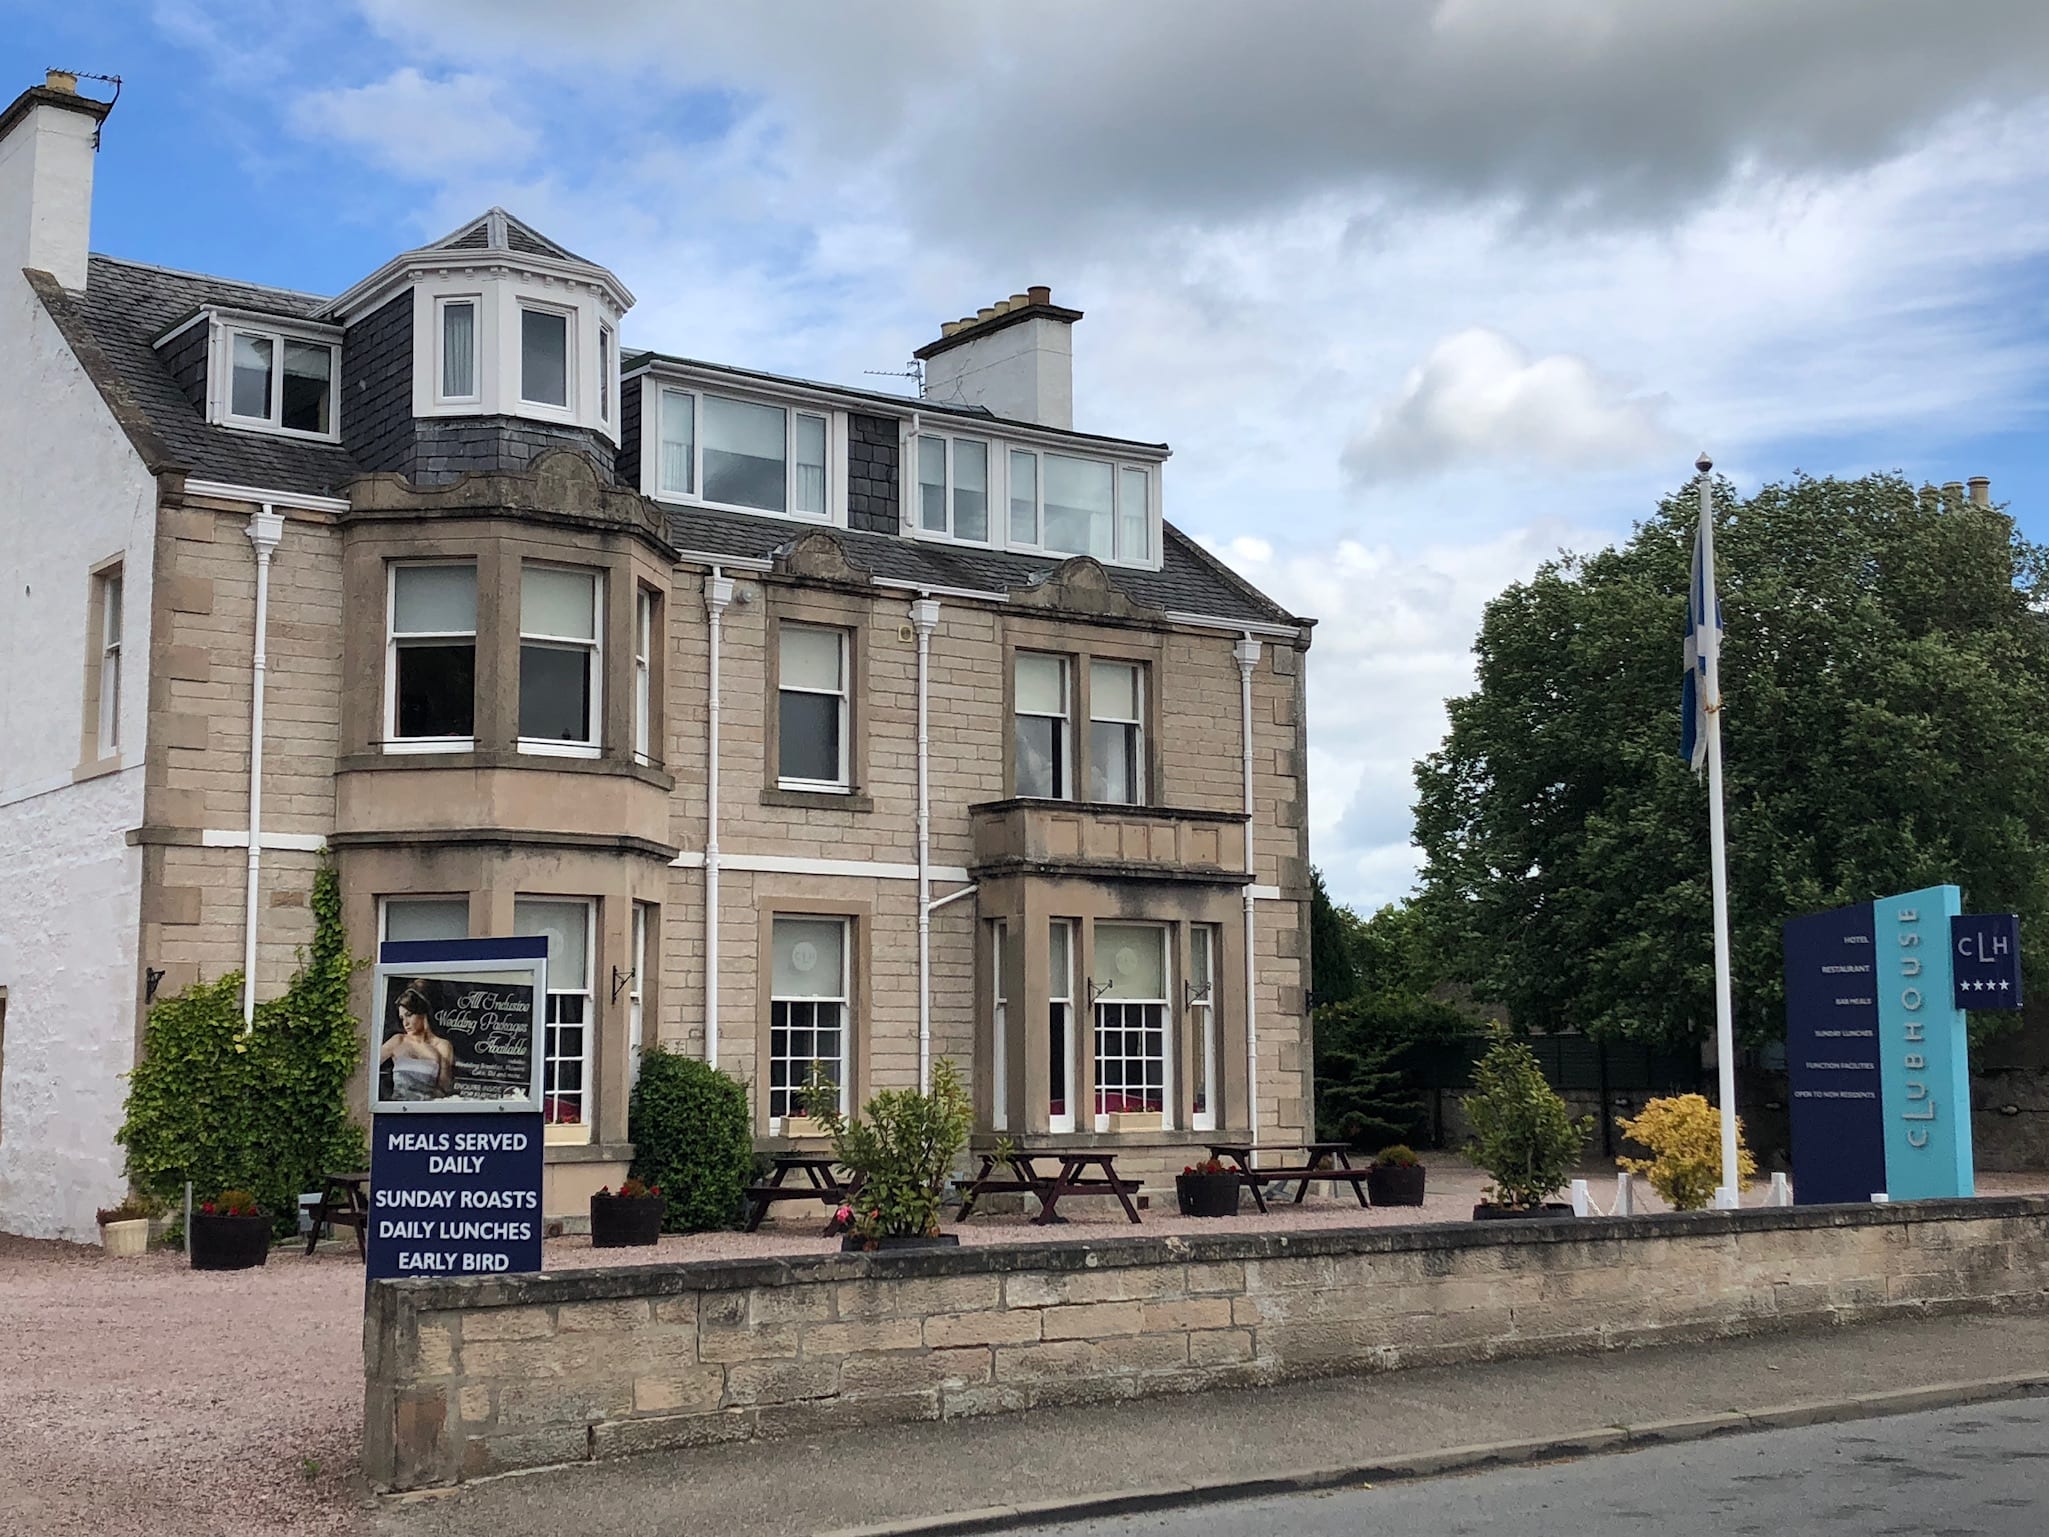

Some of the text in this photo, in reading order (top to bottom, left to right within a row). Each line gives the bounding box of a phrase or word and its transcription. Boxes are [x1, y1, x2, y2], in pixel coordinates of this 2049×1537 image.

[1843, 935, 1870, 944] HOTEL
[1958, 932, 2008, 963] CLH
[1821, 965, 1870, 973] RESTAURANT
[457, 991, 530, 1012] All Inclusive
[434, 1009, 529, 1037] Wedding Packages
[1898, 908, 1936, 1148] CLUBHOUSE
[474, 1035, 528, 1056] Available
[388, 1133, 528, 1151] MEALS SERVED
[428, 1156, 485, 1174] DAILY
[375, 1190, 538, 1209] SUNDAY ROASTS
[379, 1221, 532, 1241] DAILY LUNCHES
[398, 1252, 510, 1271] EARLY BIRD
